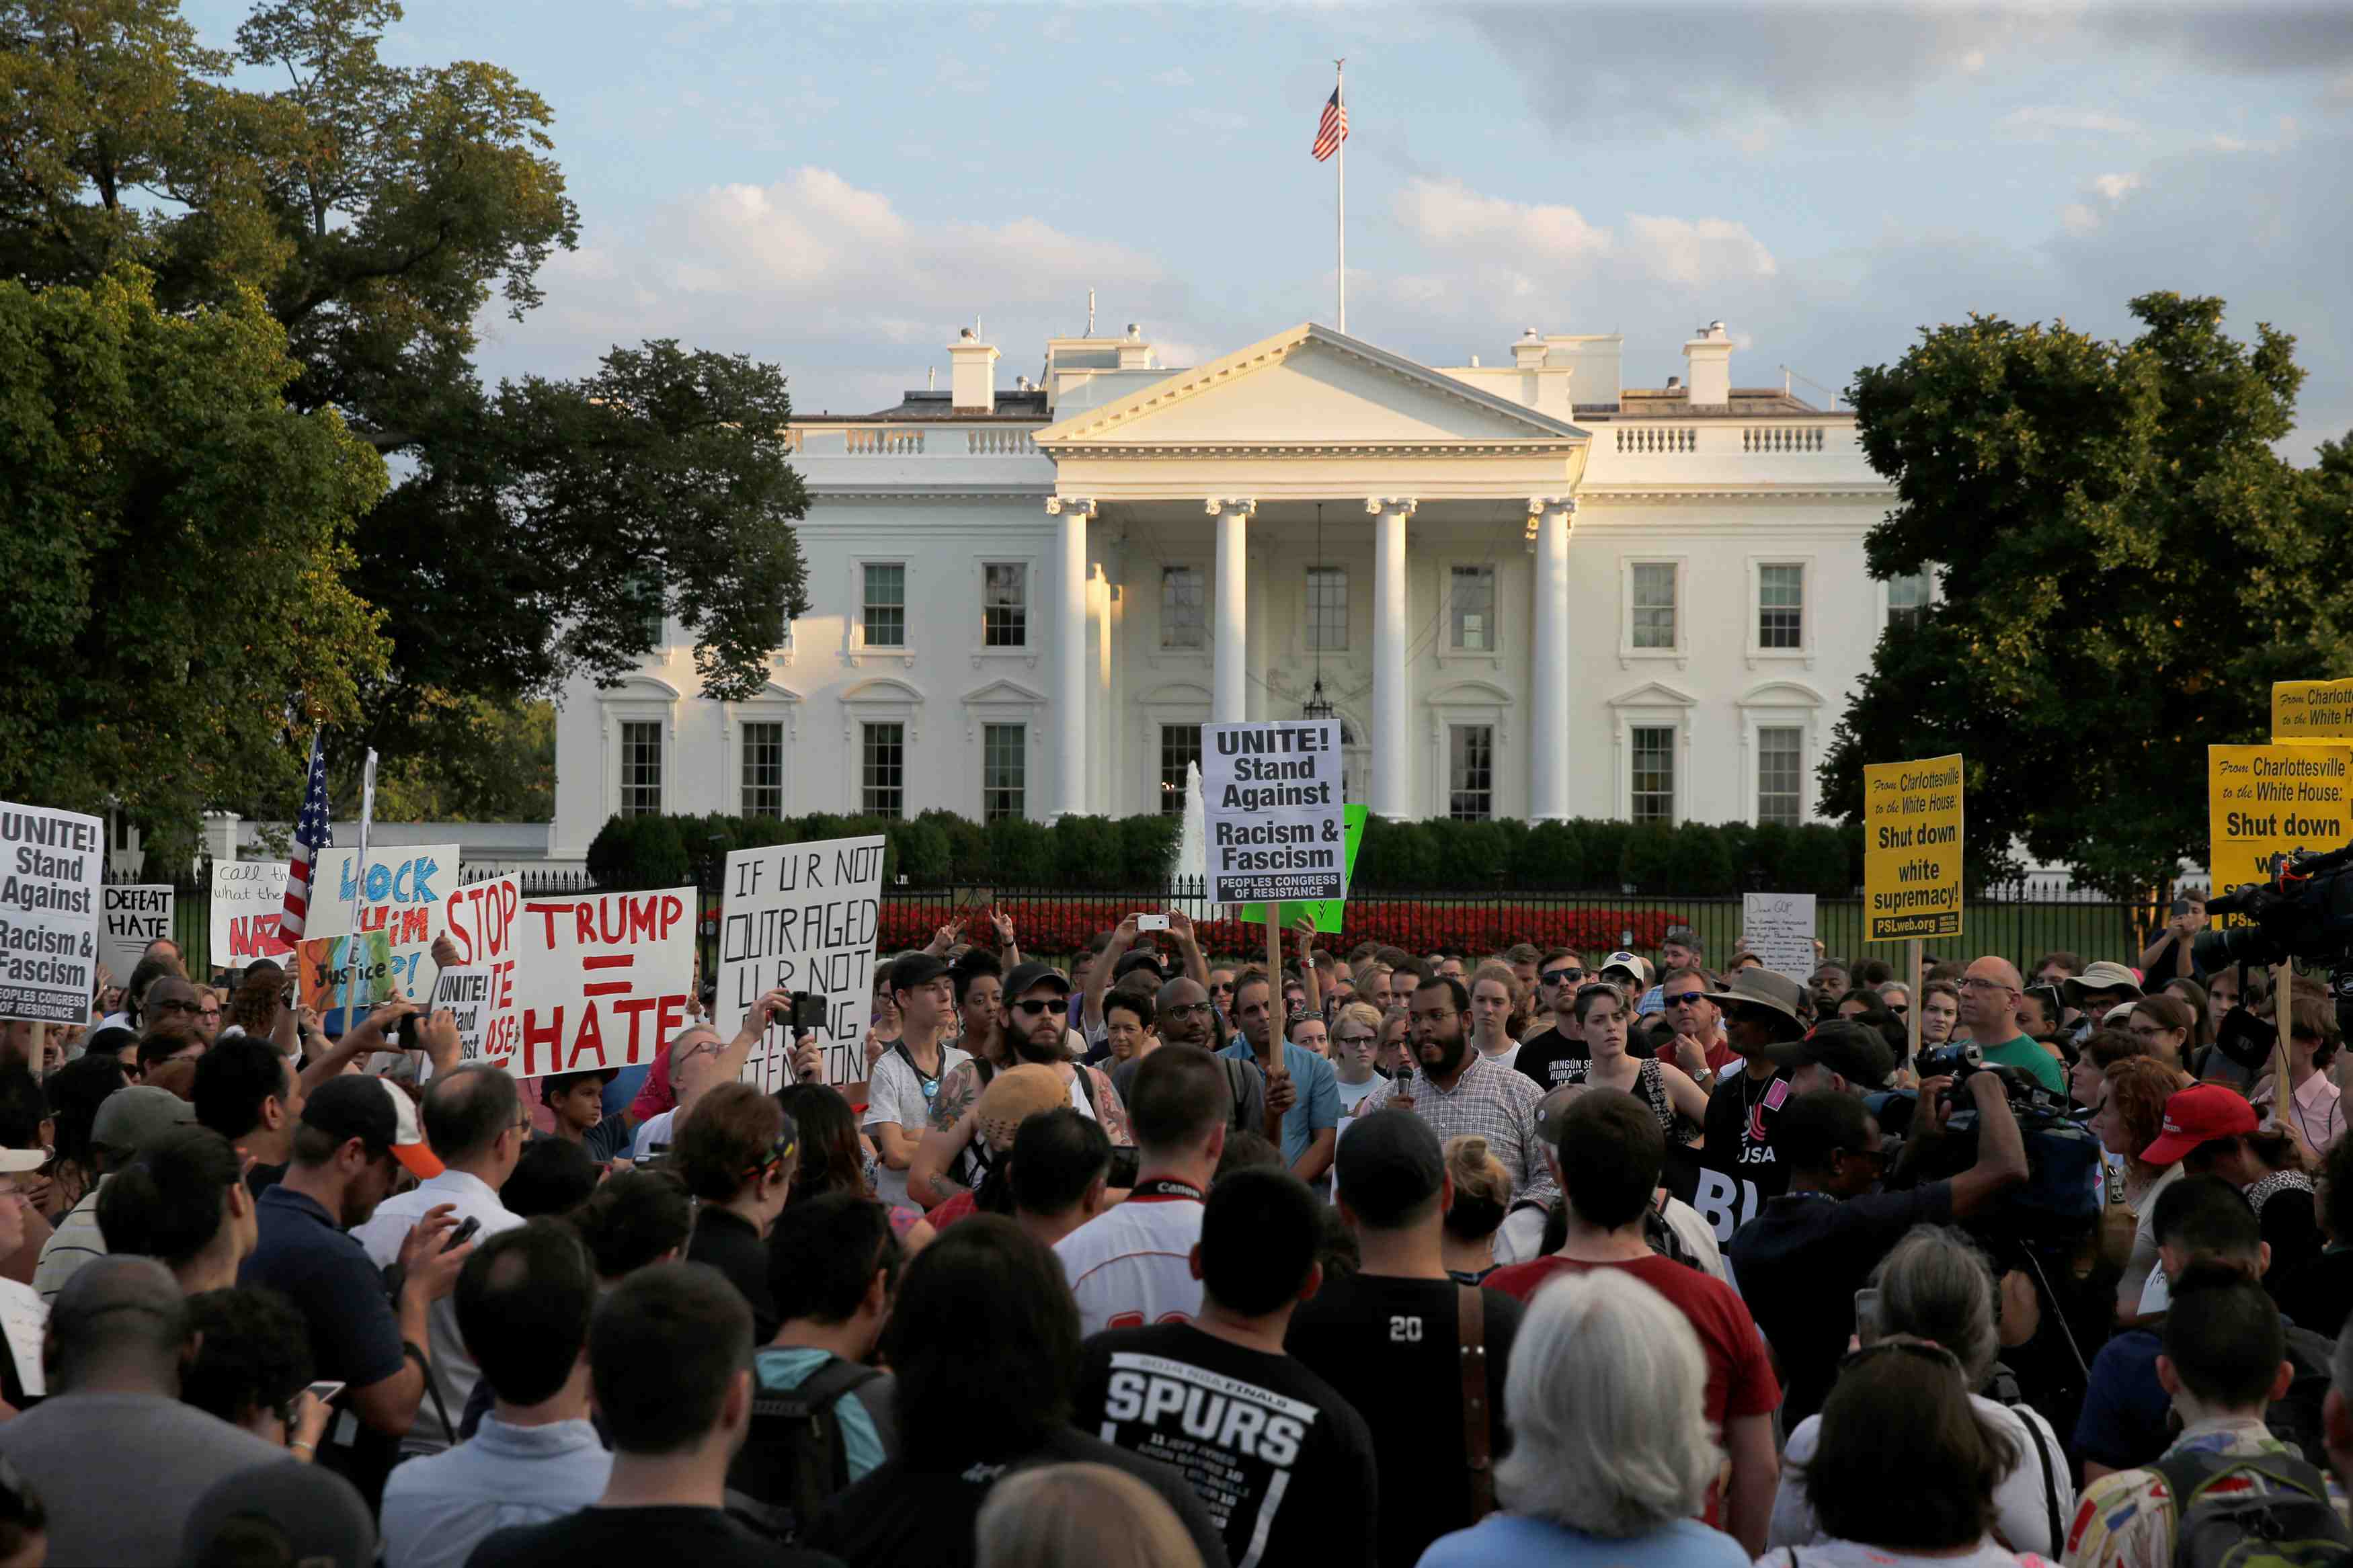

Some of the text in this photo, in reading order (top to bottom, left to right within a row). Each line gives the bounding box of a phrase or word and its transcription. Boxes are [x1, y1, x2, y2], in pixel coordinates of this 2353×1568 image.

[2280, 688, 2353, 706] From Charlott
[2282, 715, 2291, 725] to
[2292, 712, 2307, 725] the
[2310, 709, 2341, 726] White
[1217, 727, 1329, 755] UNITE!
[1234, 755, 1316, 782] Stand
[1873, 766, 1959, 793] From Charlottesville
[2219, 757, 2346, 777] From Charlottesville
[1222, 781, 1330, 812] Against
[1876, 794, 1958, 815] to the White House:
[2223, 782, 2343, 802] to the White House:
[1, 812, 95, 853] UNITE!
[1216, 819, 1339, 846] Racism &
[1878, 823, 1956, 849] Shut down
[2227, 812, 2340, 837] Shut down
[16, 846, 83, 882] Stand
[735, 845, 885, 897] IF U R NOT
[1222, 845, 1334, 871] Fascism
[1899, 858, 1940, 882] white
[271, 866, 290, 882] th
[339, 856, 439, 904] LOCK
[1220, 874, 1337, 889] PEOPLES CONGRESS
[1, 876, 91, 914] Against
[105, 889, 172, 913] DEFEAT
[214, 885, 284, 900] what the
[1234, 886, 1324, 899] OF RESISTANCE
[1874, 881, 1958, 914] supremacy!
[108, 914, 169, 938] HATE
[229, 913, 296, 958] NAZ
[446, 880, 517, 966] STOP
[524, 895, 683, 950] TRUMP
[725, 899, 879, 963] OUTRAGED
[1877, 917, 1936, 934] PSLweb.org
[79, 931, 93, 958] &
[314, 961, 387, 989] Jusice
[440, 975, 488, 1002] UNITE!
[739, 964, 759, 1009] U
[809, 949, 871, 995] NOT
[0, 1001, 74, 1018] OF RESISTANCE
[38, 991, 85, 1007] CONGRESS
[523, 994, 687, 1075] HATE
[1157, 1182, 1200, 1198] Canon
[1389, 1315, 1423, 1342] 20
[1226, 1381, 1289, 1409] FINALS
[1105, 1370, 1305, 1467] SPURS
